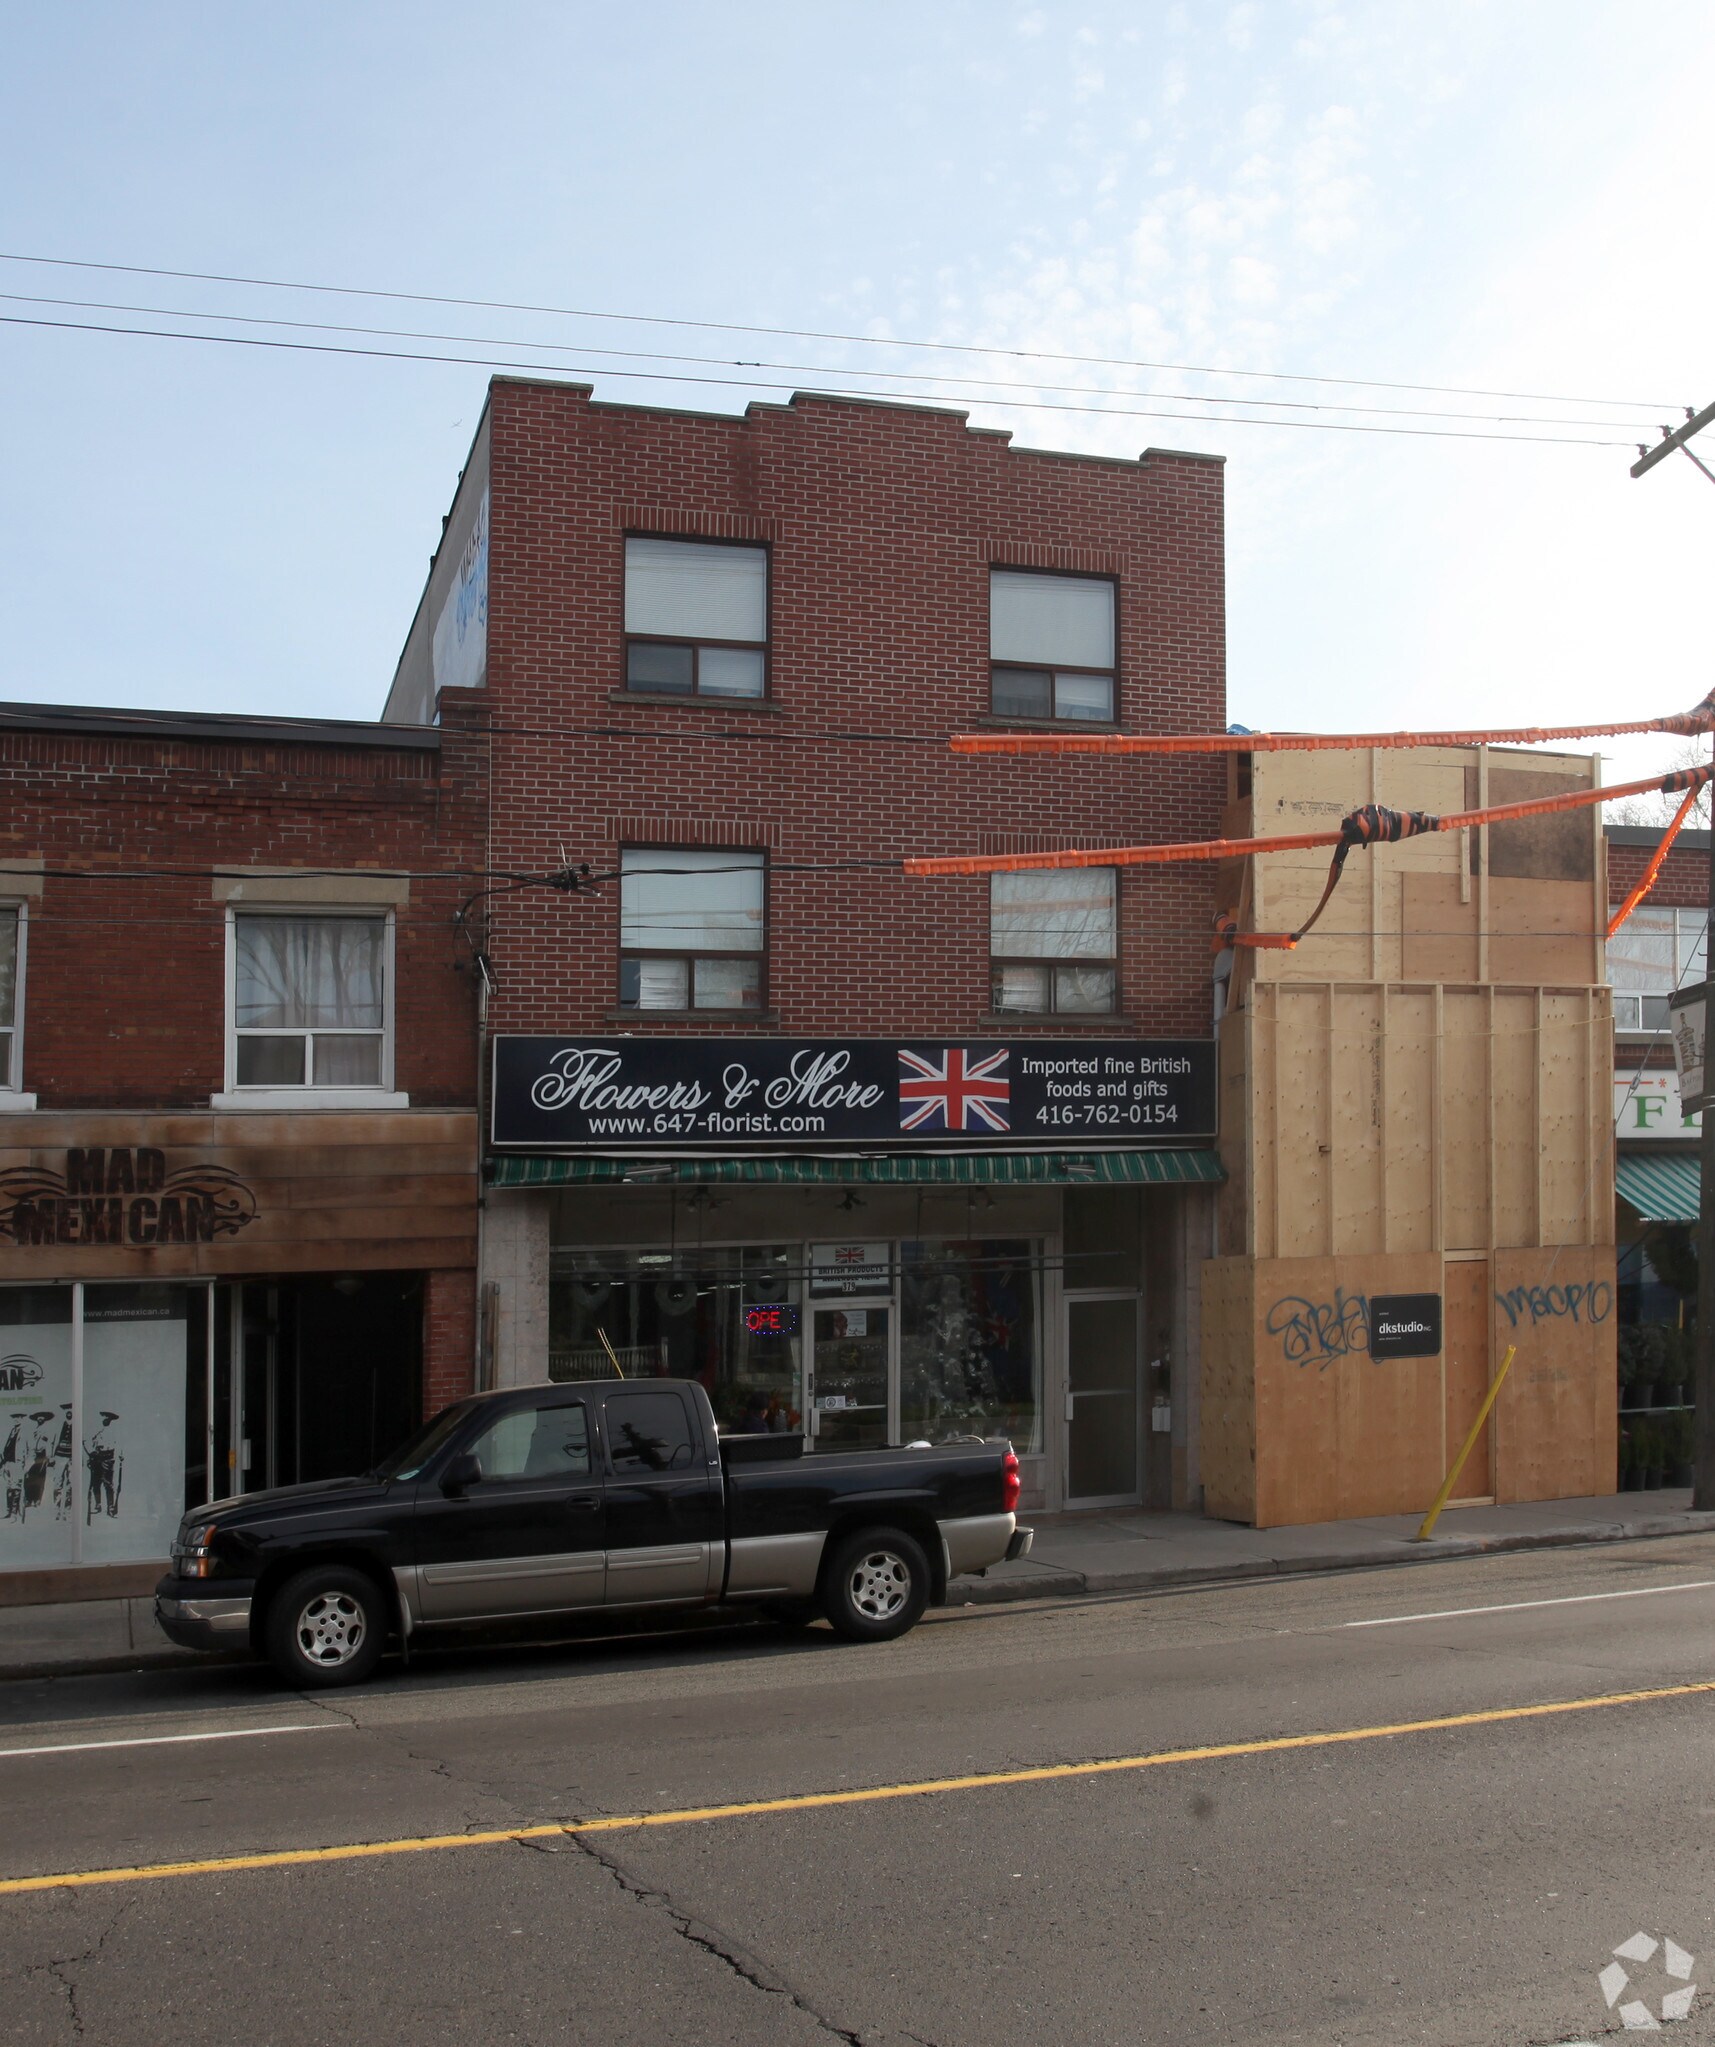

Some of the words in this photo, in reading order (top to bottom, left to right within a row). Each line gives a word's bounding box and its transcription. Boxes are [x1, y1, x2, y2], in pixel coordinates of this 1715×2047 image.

[1022, 1057, 1098, 1077] Imported
[1104, 1057, 1135, 1074] fine
[1140, 1057, 1191, 1074] British
[532, 1048, 711, 1110] Flowers
[723, 1063, 760, 1109] &
[765, 1049, 884, 1109] More
[1046, 1081, 1092, 1098] foods
[1097, 1080, 1127, 1096] and
[1133, 1080, 1168, 1100] gifts
[588, 1112, 826, 1134] www.647-florist.com
[1036, 1104, 1178, 1124] 416-762-0154
[67, 1148, 165, 1194] MAD
[14, 1197, 214, 1244] MEXICAN
[1379, 1321, 1424, 1334] dkstudio
